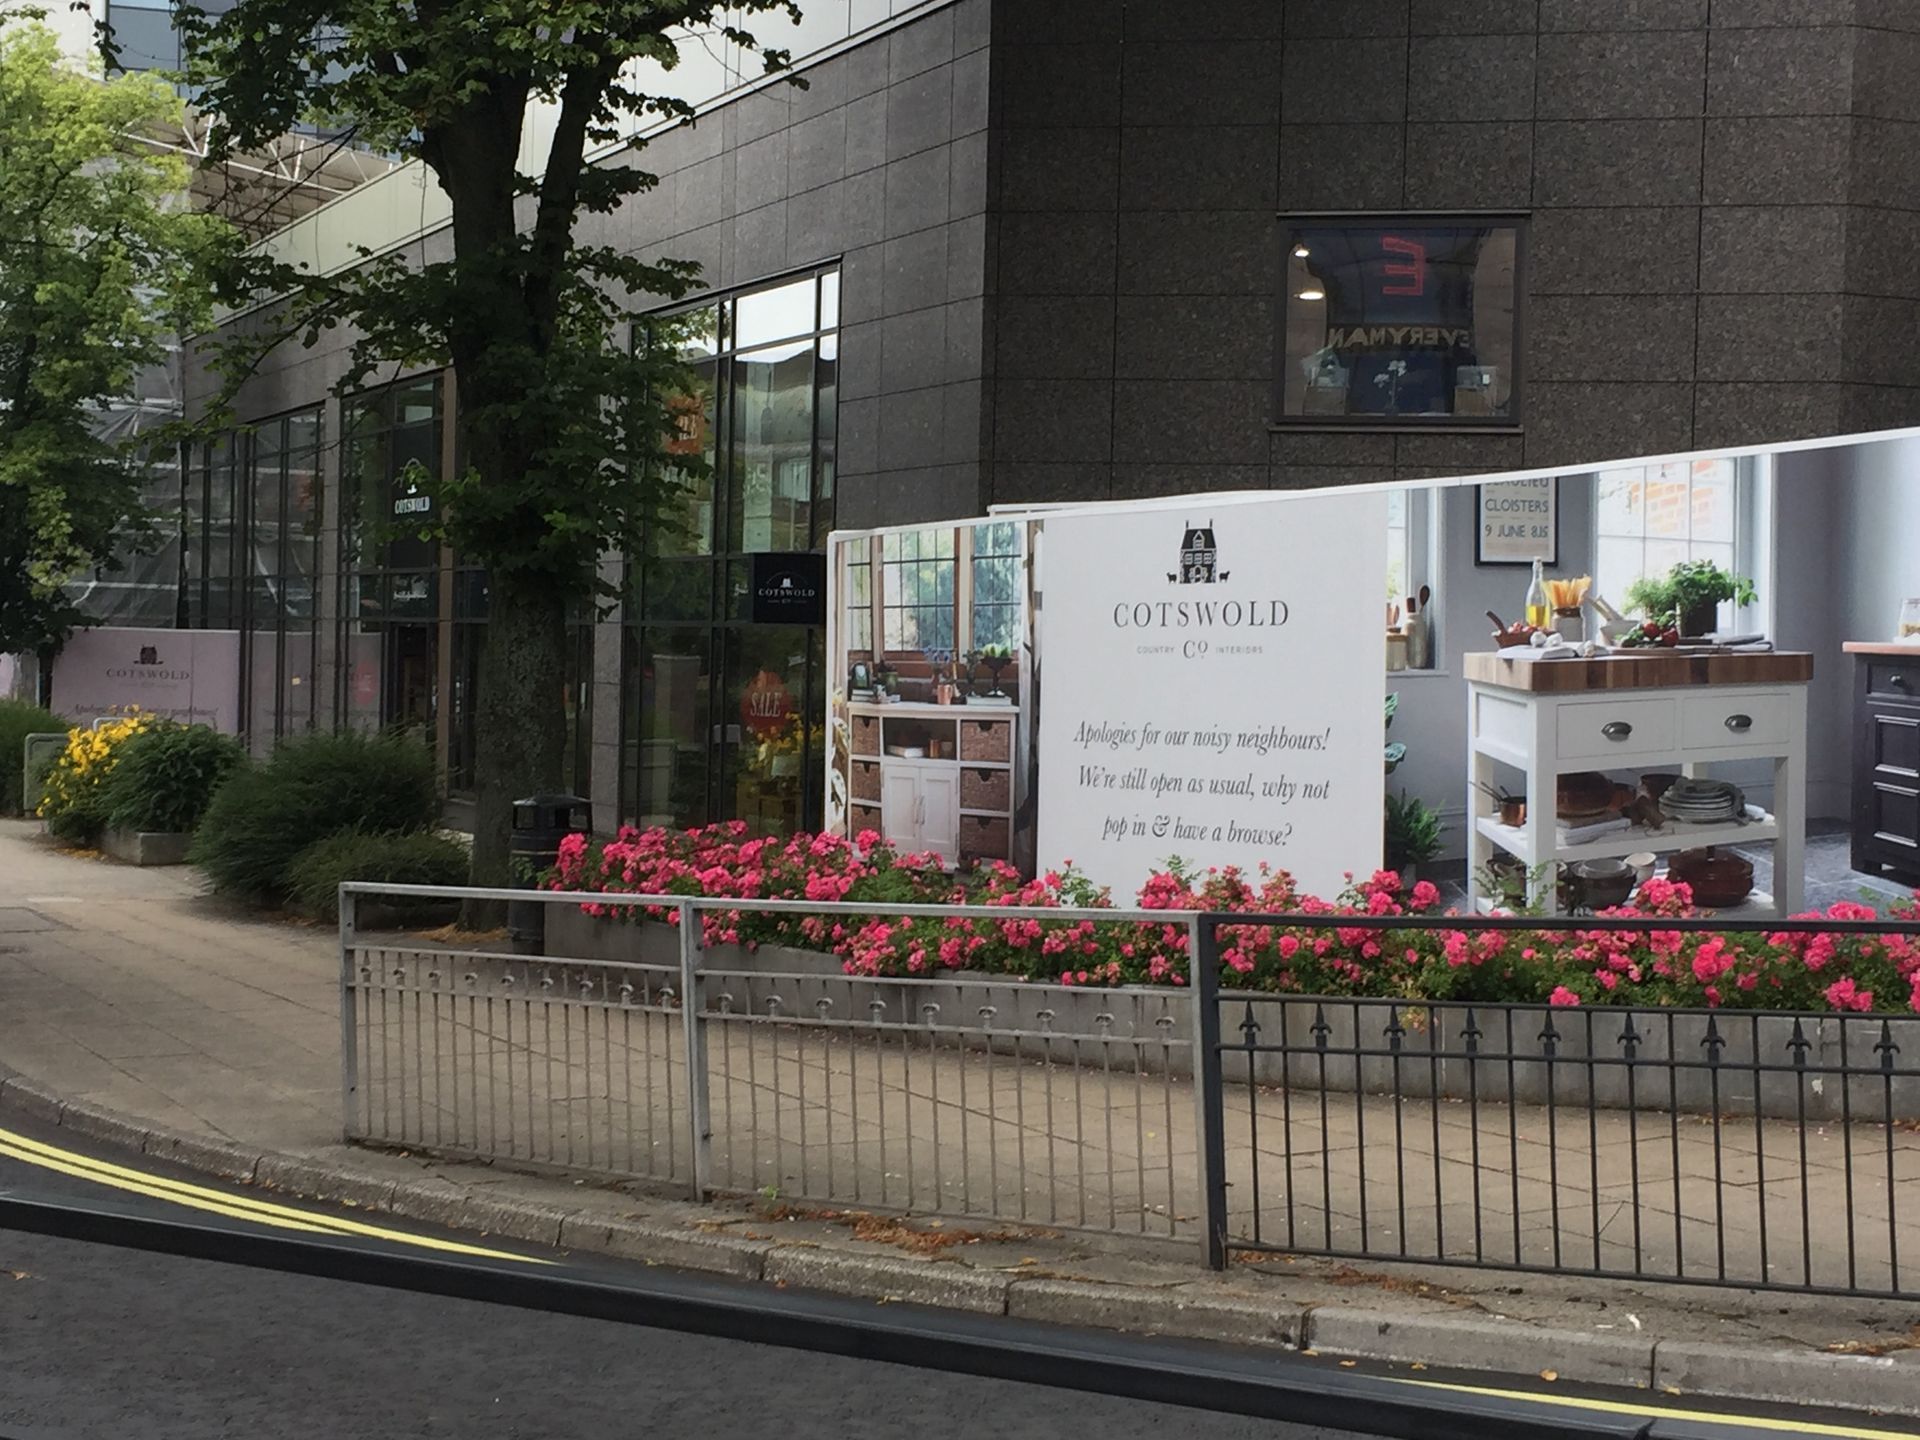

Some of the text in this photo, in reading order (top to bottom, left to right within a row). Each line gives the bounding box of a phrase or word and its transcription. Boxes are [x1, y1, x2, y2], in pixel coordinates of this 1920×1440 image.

[1484, 498, 1549, 513] CLOISTERS
[1485, 524, 1492, 537] 9
[1497, 524, 1526, 538] JUNE
[758, 588, 815, 597] COTSWOLD
[1113, 600, 1289, 628] COTSWOLD
[1136, 645, 1175, 655] COUNTRY
[1215, 645, 1263, 655] INTERIORS
[106, 667, 190, 681] COTSWOLD
[750, 692, 782, 718] SALE
[1073, 720, 1331, 756] Apologies for our noisy neighbours!
[1119, 767, 1148, 790] still
[1150, 772, 1183, 799] open
[1187, 777, 1205, 793] as
[1209, 772, 1255, 801] usual,
[1261, 774, 1297, 805] why
[1302, 779, 1330, 800] not
[1102, 813, 1293, 847] pop in & have a browse?
